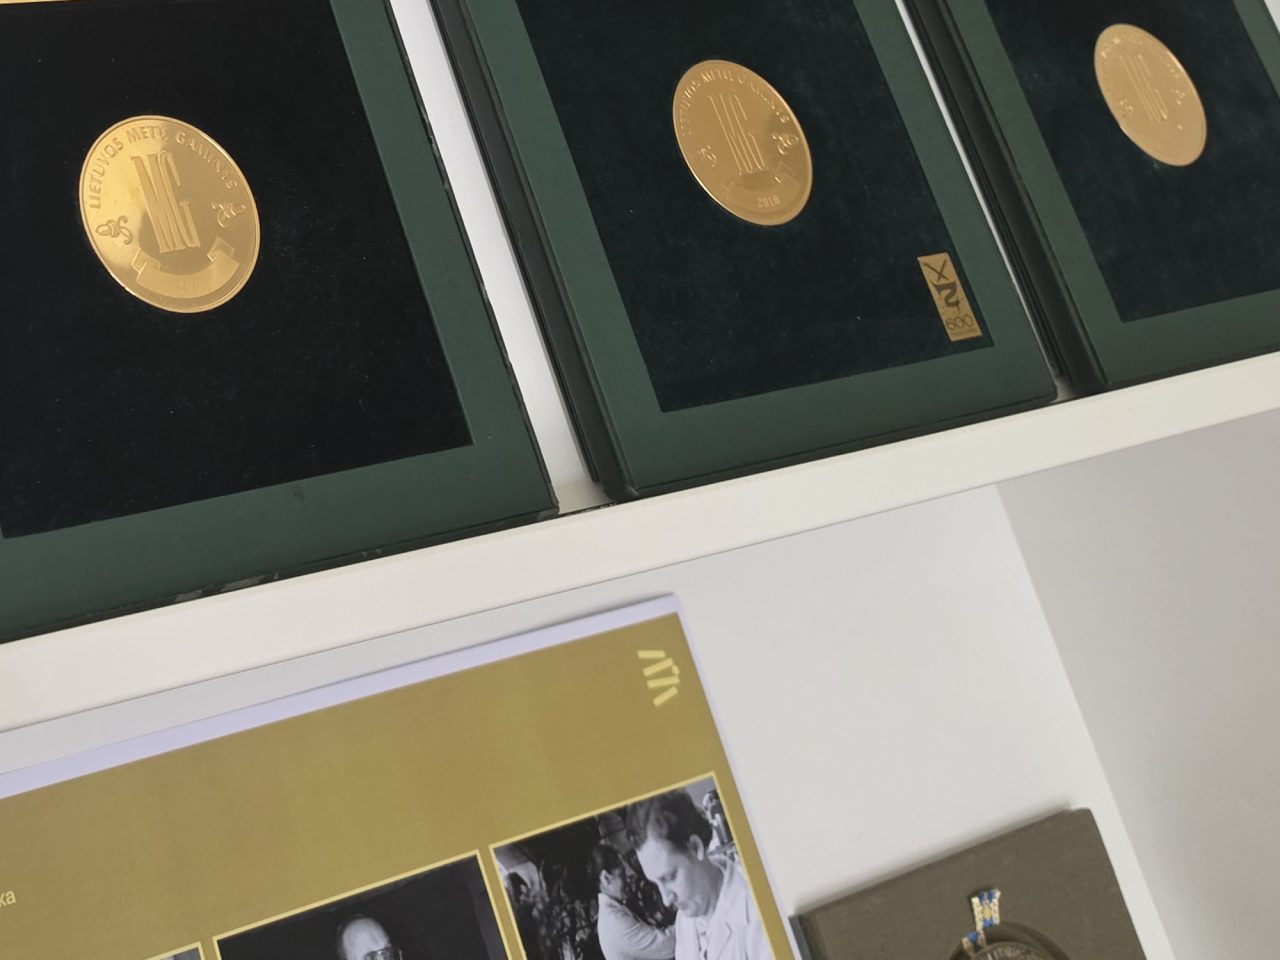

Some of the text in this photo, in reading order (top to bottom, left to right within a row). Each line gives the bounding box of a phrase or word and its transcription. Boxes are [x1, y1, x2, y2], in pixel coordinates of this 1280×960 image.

[88, 137, 125, 210] LIETUVOS
[125, 124, 168, 144] METŲ
[755, 193, 782, 209] 2010
